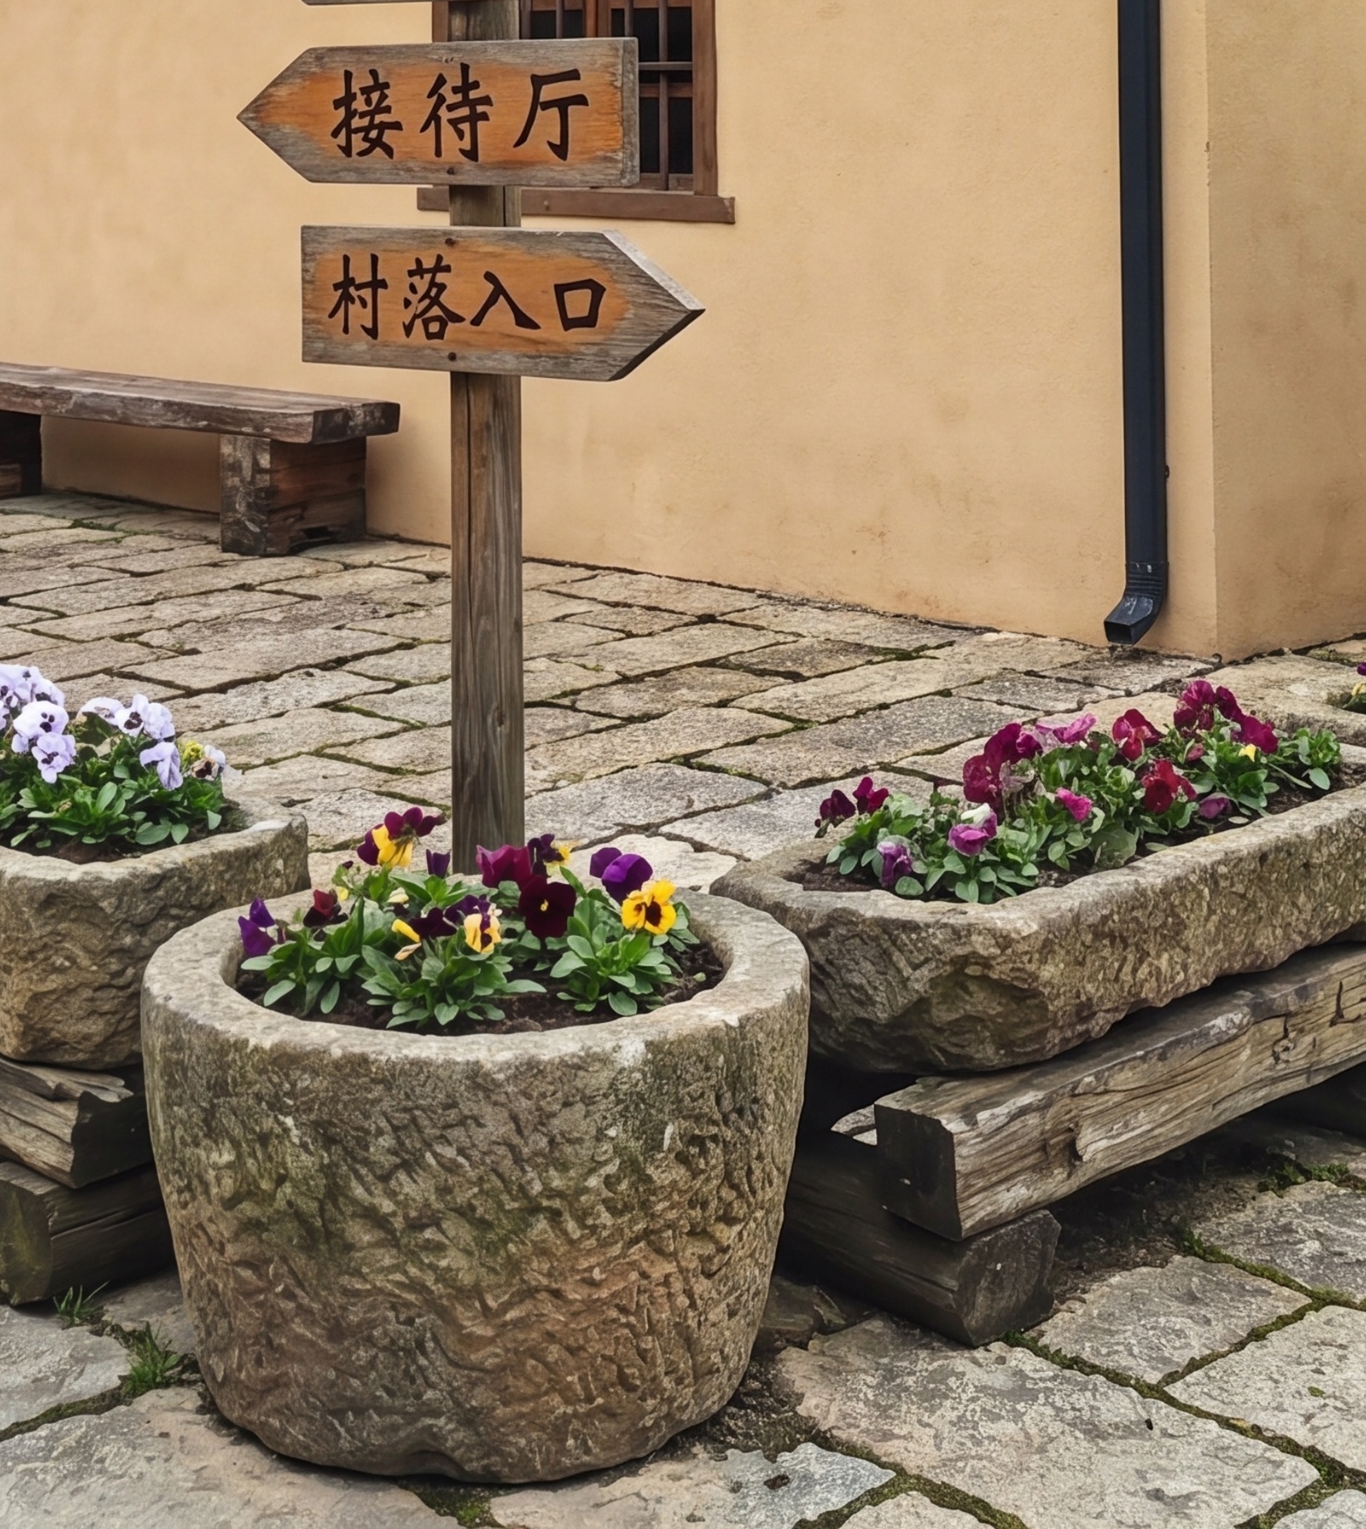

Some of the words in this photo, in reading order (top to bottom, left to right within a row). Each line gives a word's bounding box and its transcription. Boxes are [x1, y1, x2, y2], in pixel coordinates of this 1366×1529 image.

[330, 62, 590, 163] 接待厅
[327, 252, 607, 341] 村落入口
